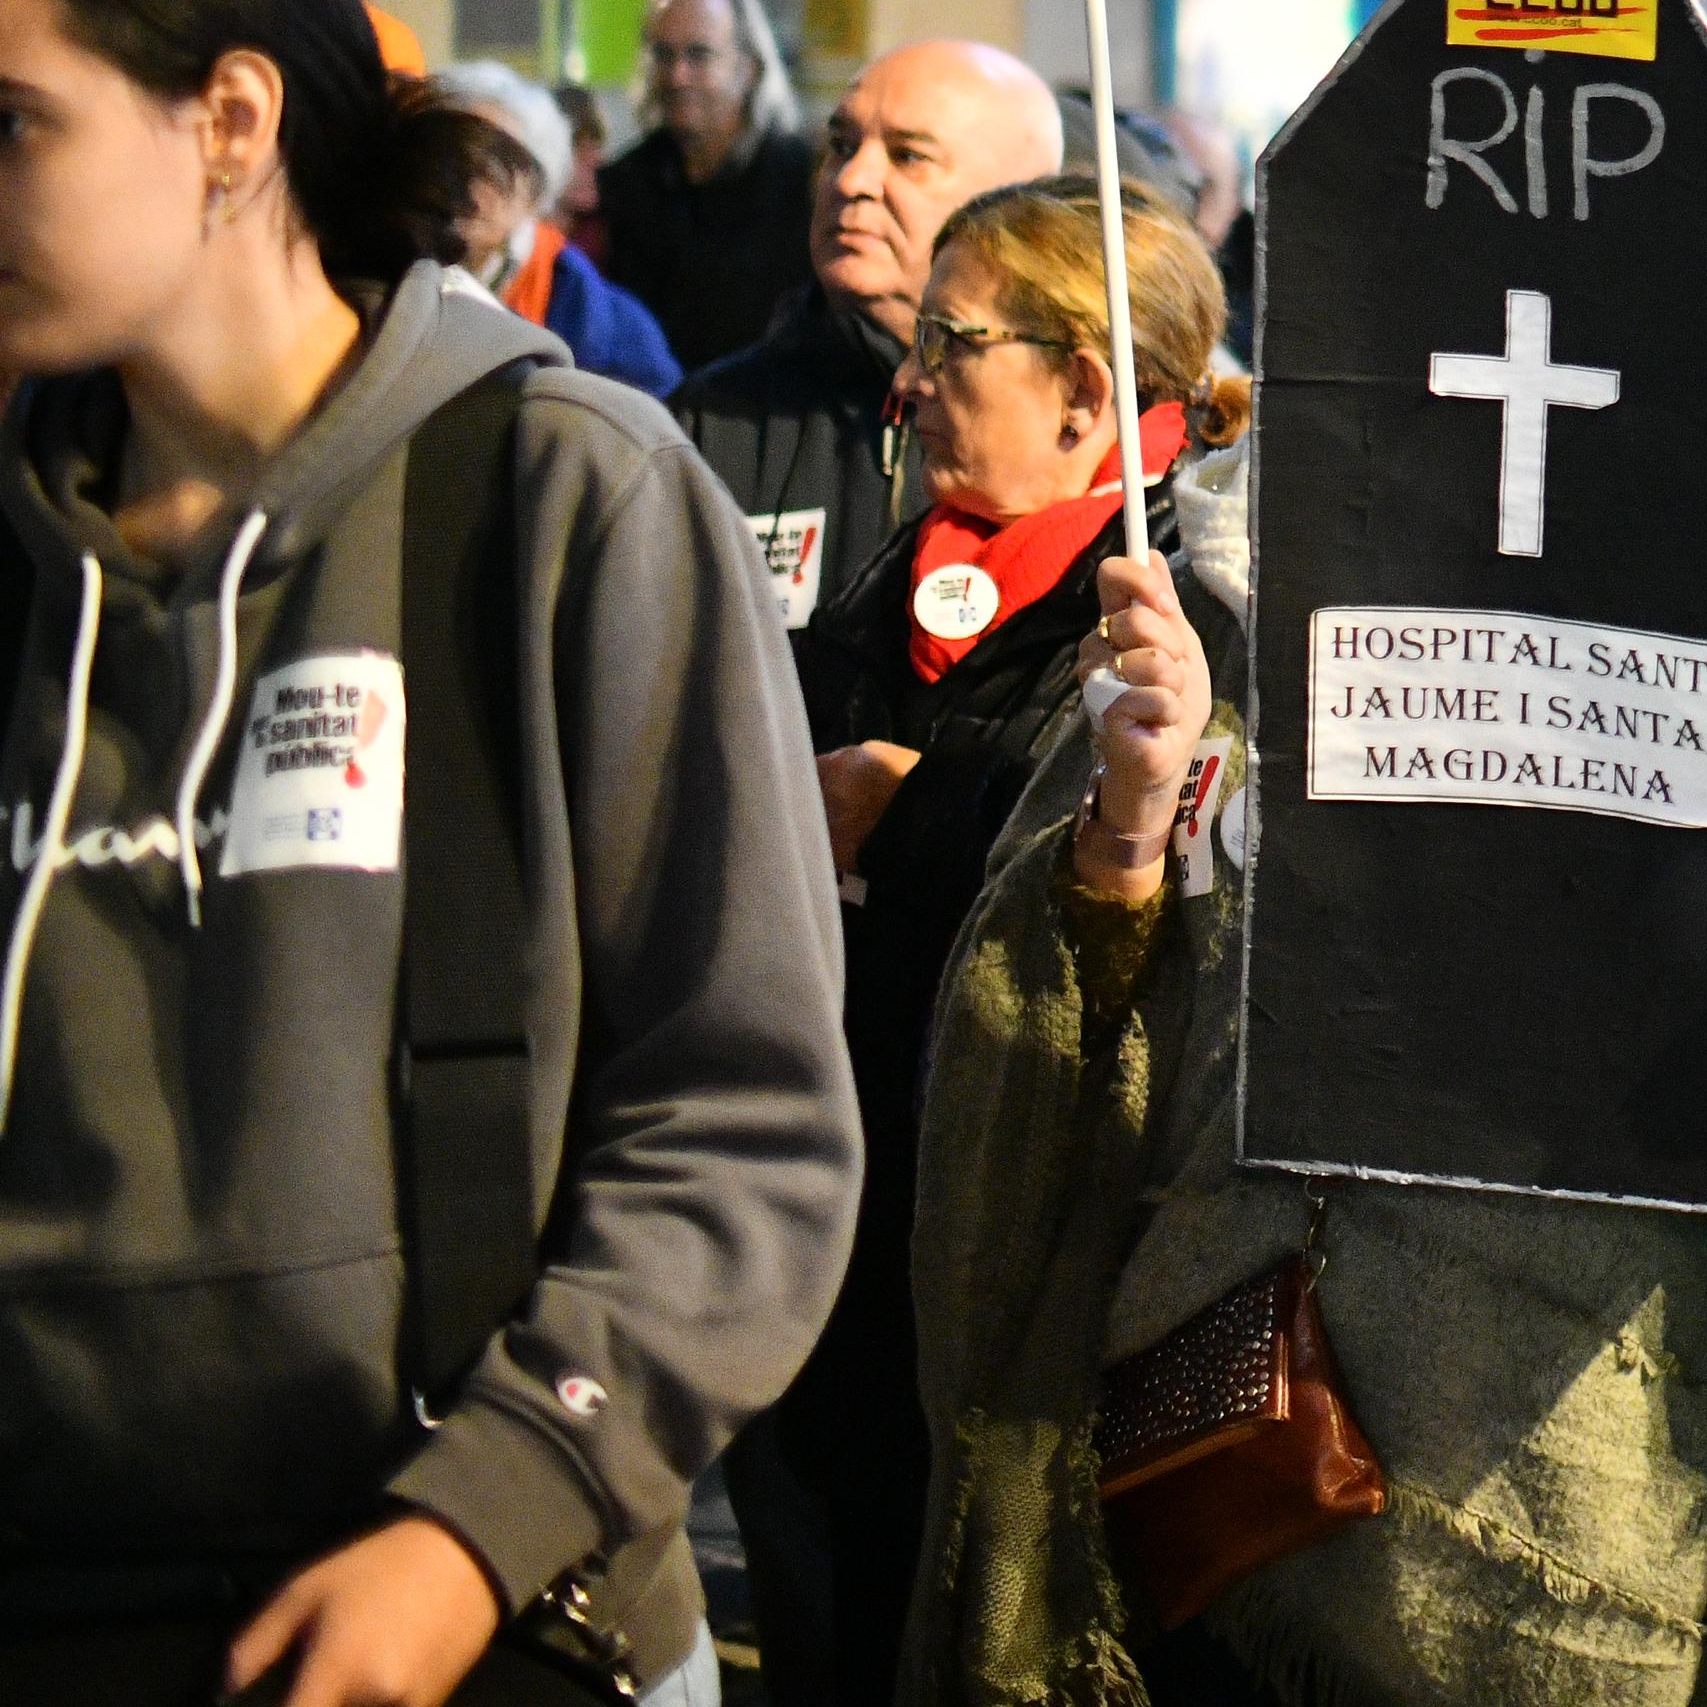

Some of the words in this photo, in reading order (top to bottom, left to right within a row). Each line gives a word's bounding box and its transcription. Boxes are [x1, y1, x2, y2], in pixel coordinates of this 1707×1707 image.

[1424, 49, 1667, 222] RIP
[1331, 625, 1574, 672] HOSPITAL
[1329, 685, 1500, 724] JAUME
[1518, 692, 1530, 725] I
[1545, 695, 1707, 753] SANTA
[1361, 744, 1675, 806] MAGDALENA
